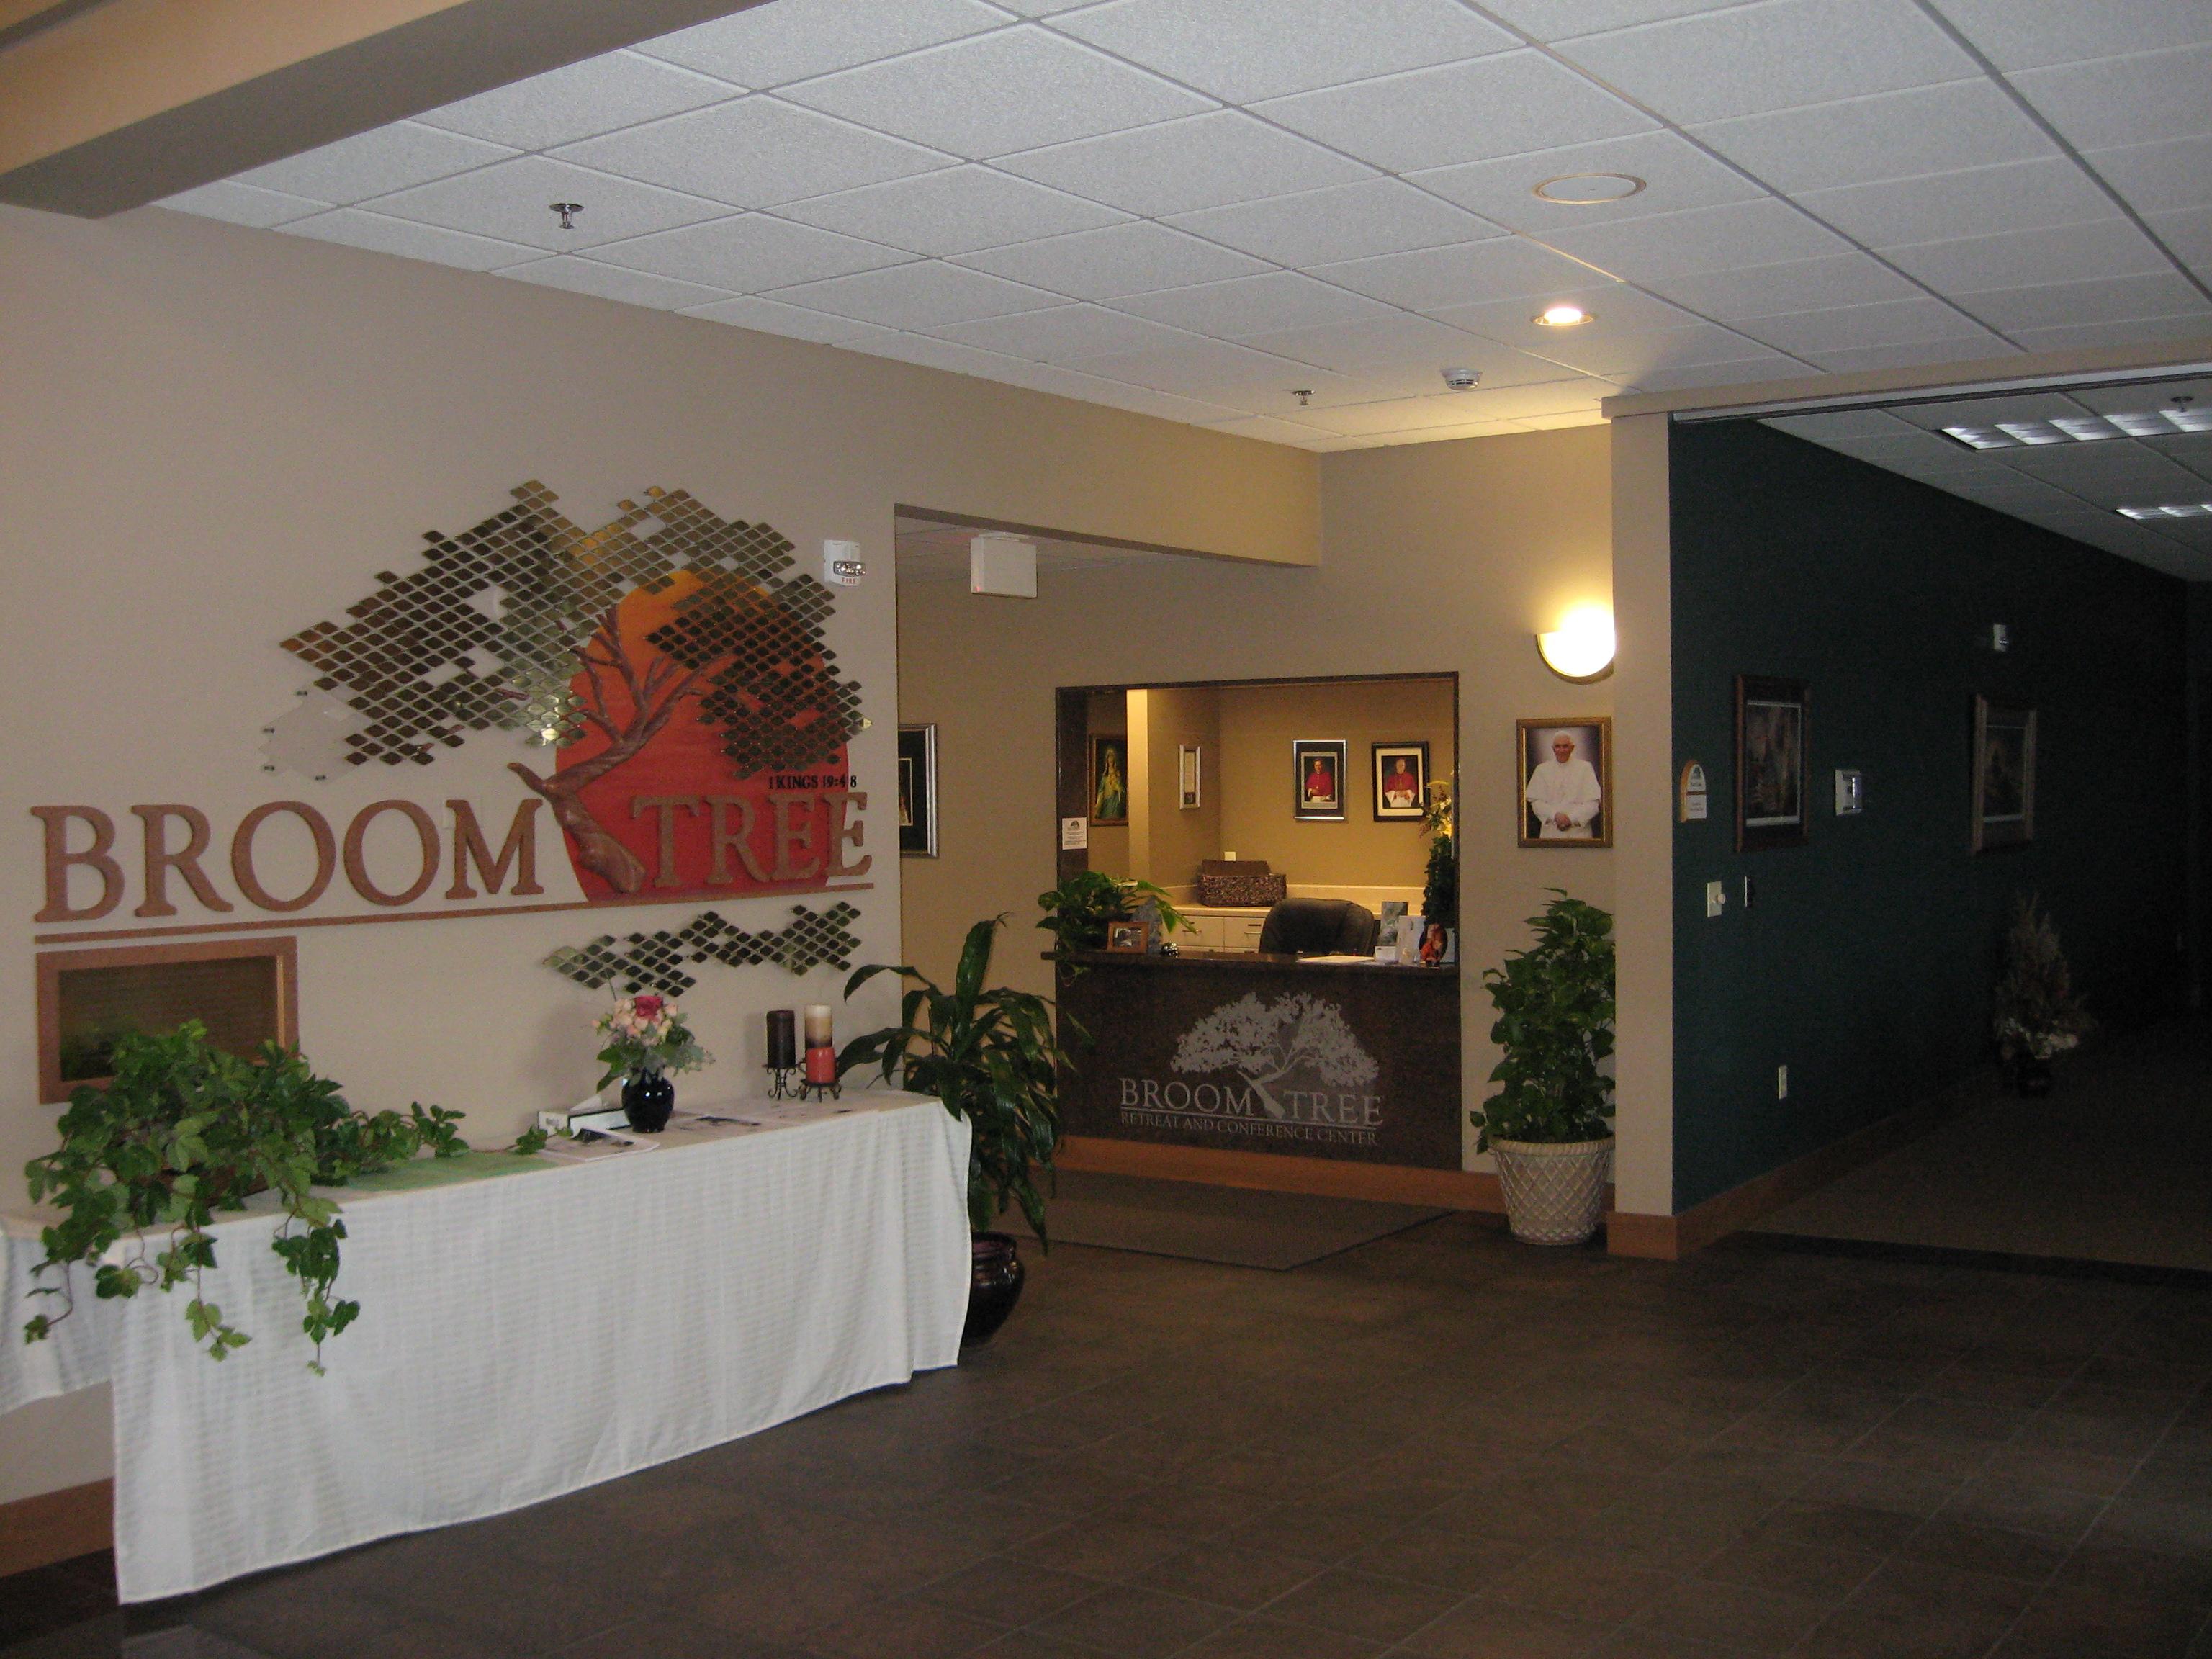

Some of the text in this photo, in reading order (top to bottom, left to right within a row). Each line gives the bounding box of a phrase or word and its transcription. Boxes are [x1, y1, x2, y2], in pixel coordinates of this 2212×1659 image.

[777, 775, 818, 789] KINGS
[30, 791, 872, 922] BROOM TREE
[1119, 1078, 1383, 1125] BROOM TREE
[1121, 1110, 1377, 1146] RETREAT AND CONFERENCE CENTER
